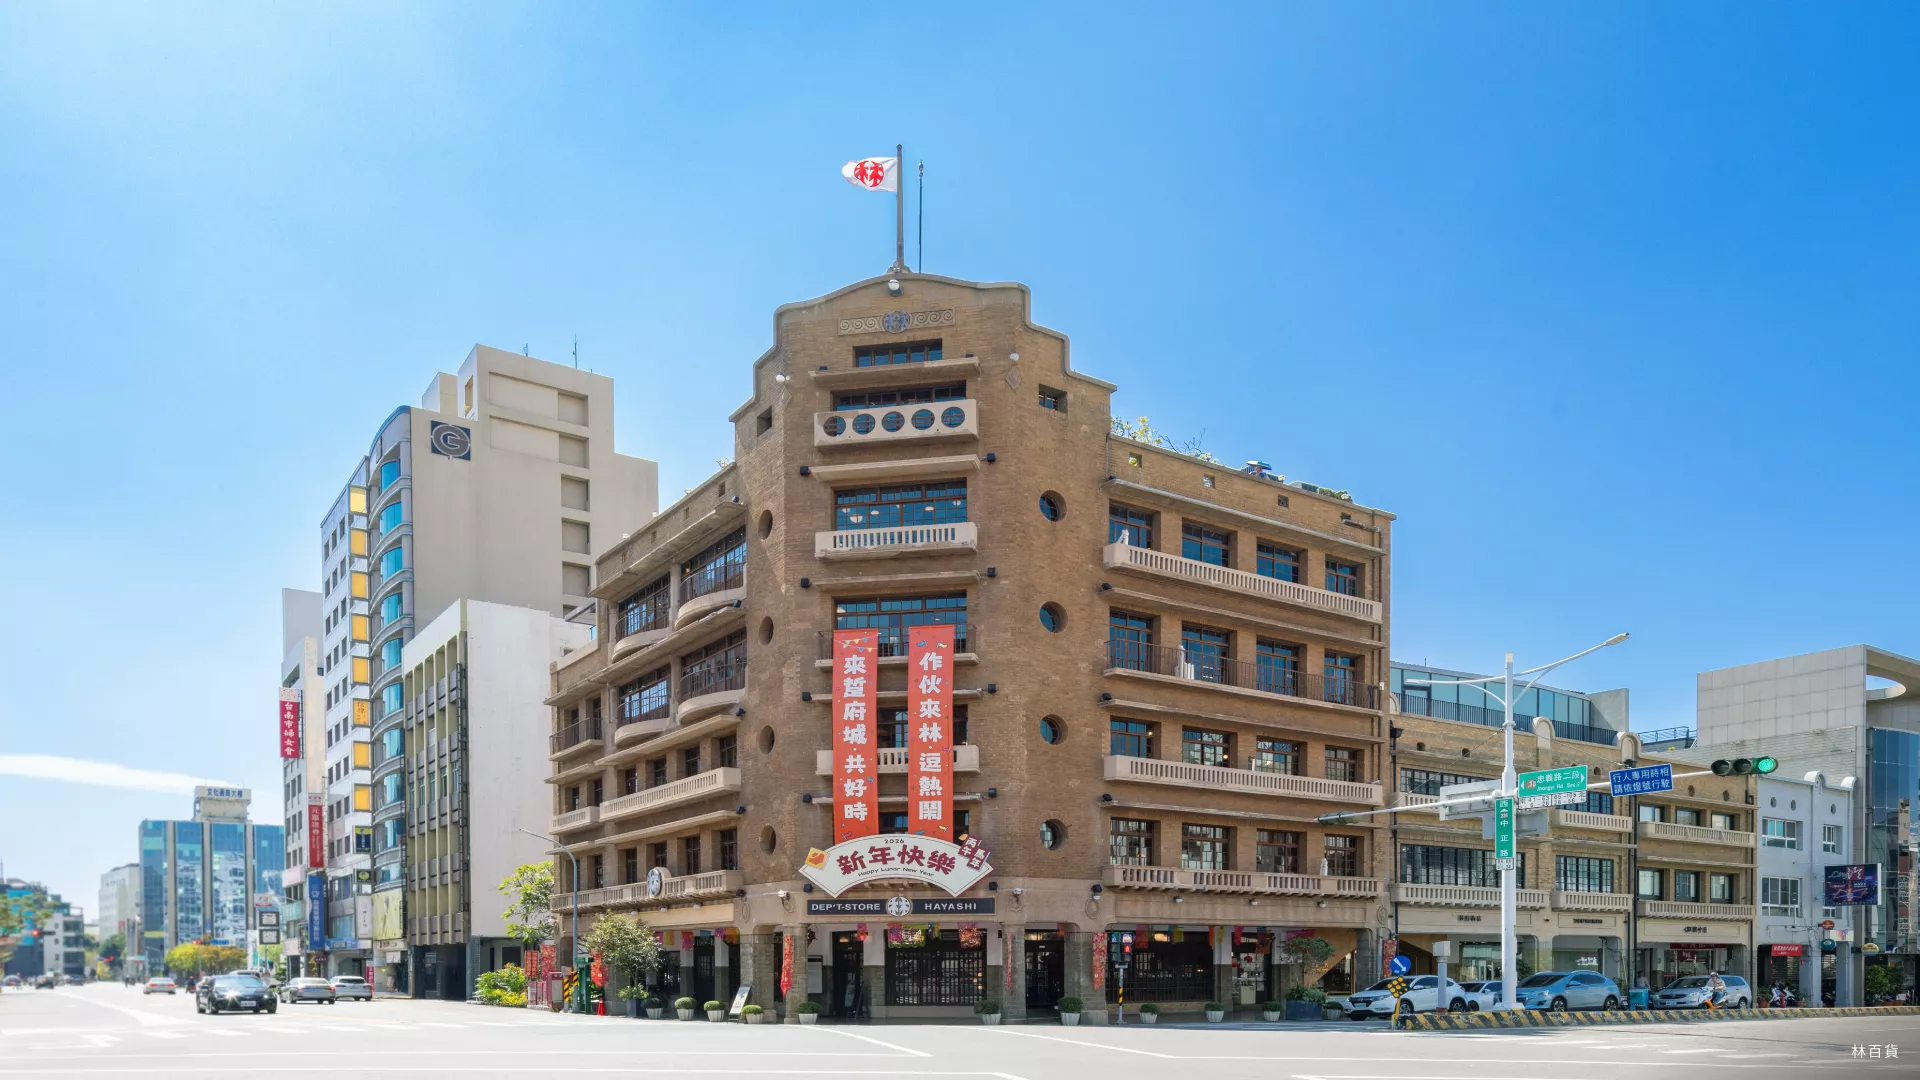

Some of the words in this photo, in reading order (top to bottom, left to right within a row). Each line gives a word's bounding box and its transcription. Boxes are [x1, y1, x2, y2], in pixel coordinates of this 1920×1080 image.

[283, 702, 295, 756] 台南市婦女會
[1536, 770, 1580, 784] 忠義路二段
[1612, 767, 1670, 783] 行人專用時相
[1614, 779, 1670, 794] 請依燈號行駛
[1499, 820, 1509, 857] 中正路
[836, 844, 956, 876] 新年快樂
[857, 868, 879, 877] Happy
[919, 869, 935, 877] Year
[924, 902, 977, 911] HAYASHI
